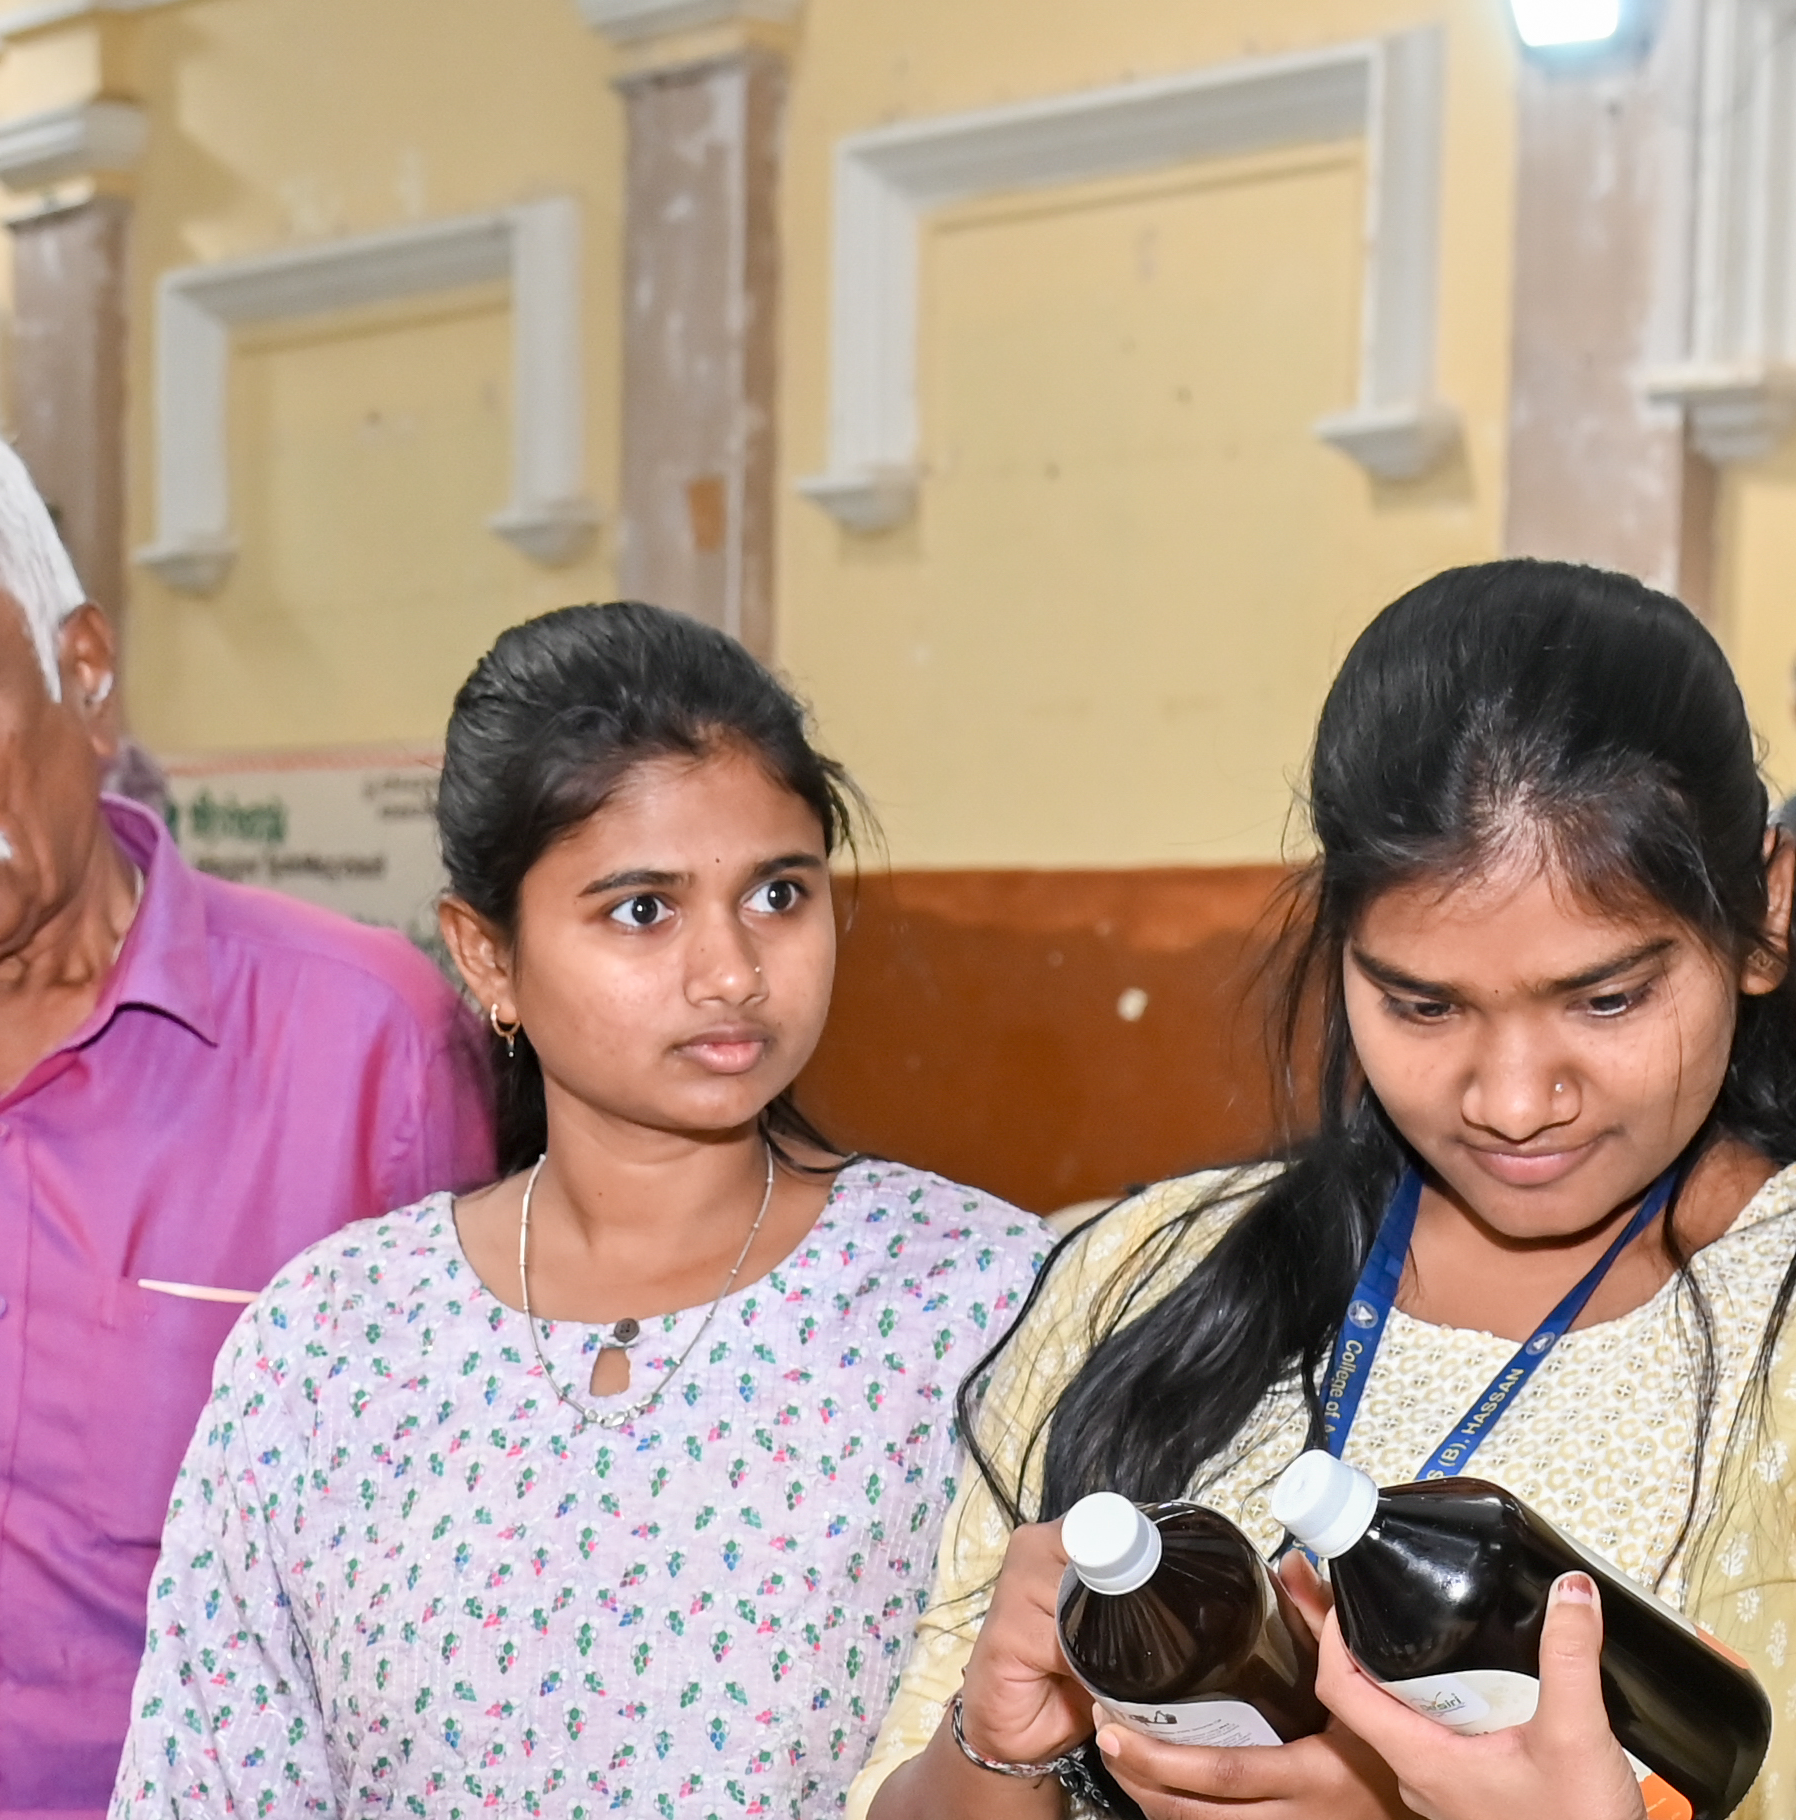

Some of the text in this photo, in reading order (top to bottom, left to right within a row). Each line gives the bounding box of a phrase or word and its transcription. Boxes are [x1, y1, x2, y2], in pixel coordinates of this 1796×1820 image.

[1329, 1339, 1362, 1398] College
[1325, 1401, 1340, 1421] of
[1462, 1368, 1524, 1435] HASSAN
